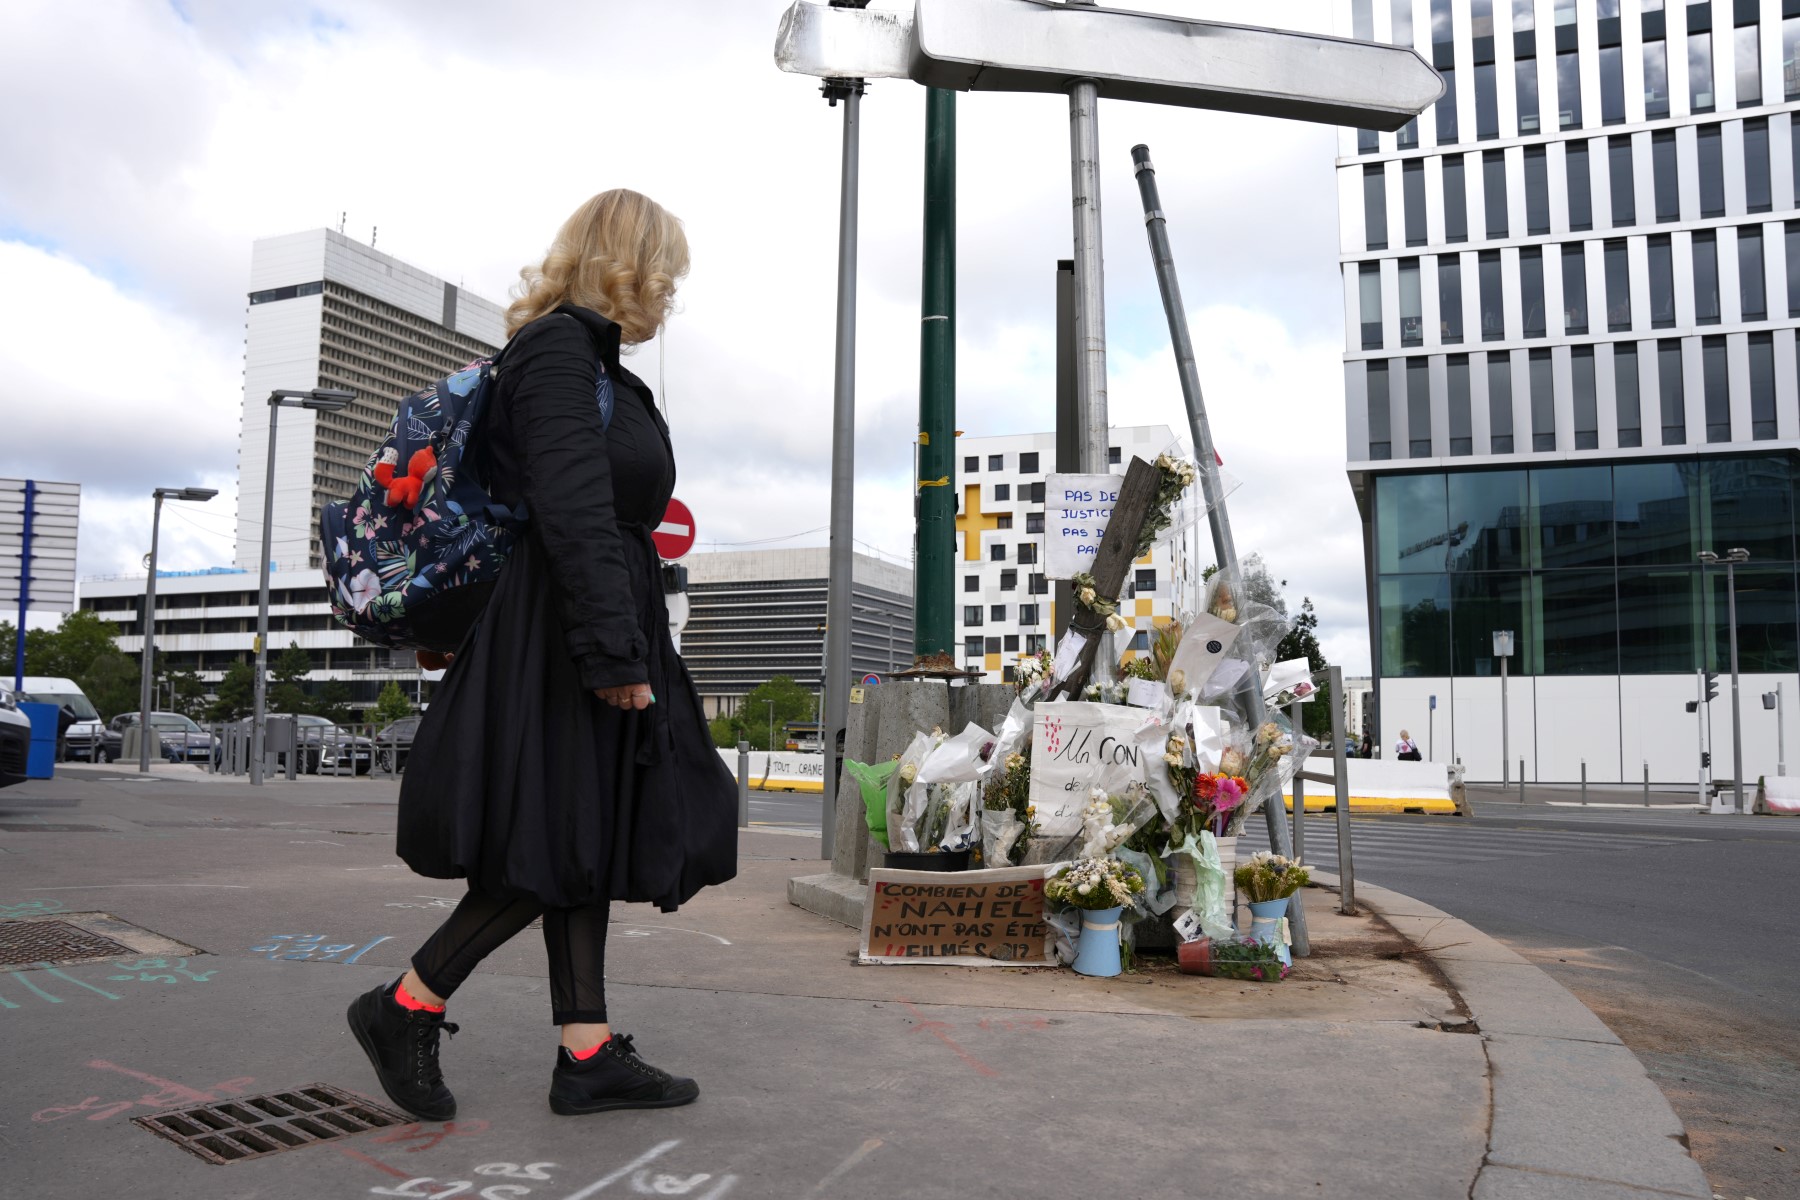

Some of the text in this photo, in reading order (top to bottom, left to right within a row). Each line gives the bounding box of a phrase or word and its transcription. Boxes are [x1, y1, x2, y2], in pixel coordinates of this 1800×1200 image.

[1065, 490, 1092, 502] PAS
[1062, 527, 1088, 537] PAS
[1077, 543, 1099, 555] PAi
[773, 761, 790, 773] TOUT
[883, 884, 1029, 899] COMBIEN DE
[900, 900, 1034, 919] NAHEL
[874, 920, 1047, 938] N'ONT PAS ÉTÉ
